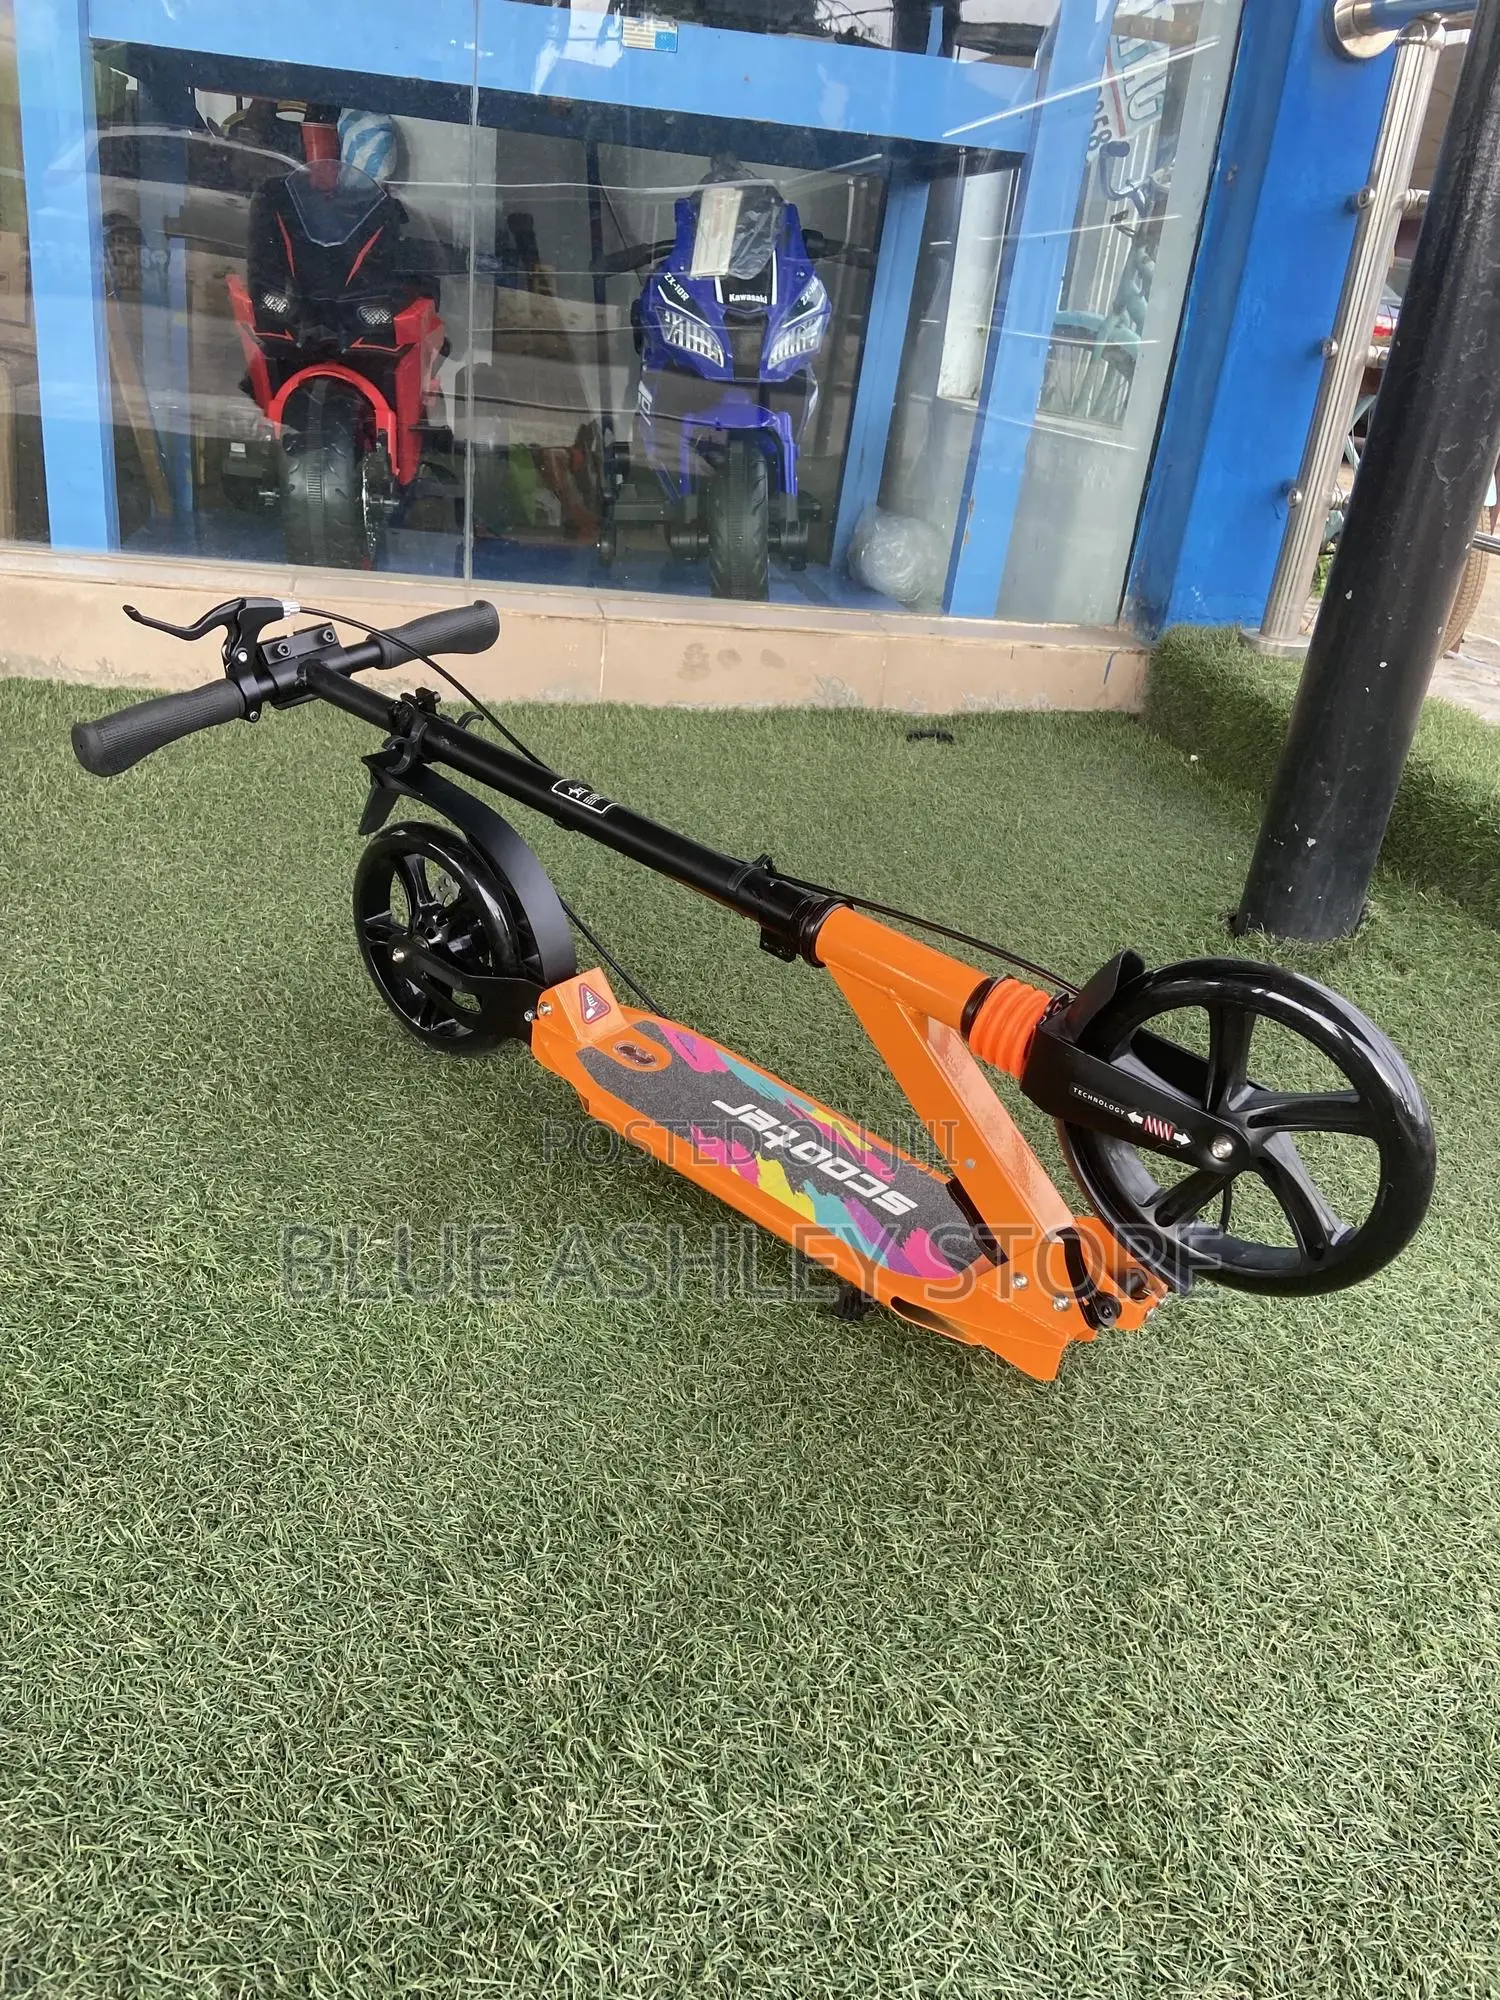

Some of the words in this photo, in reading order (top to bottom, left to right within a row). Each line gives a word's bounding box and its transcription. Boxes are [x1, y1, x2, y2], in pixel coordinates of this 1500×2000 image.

[663, 272, 691, 302] ZX-10R
[728, 293, 769, 305] Kawasaki
[1072, 1086, 1127, 1116] TECHNOLOGY
